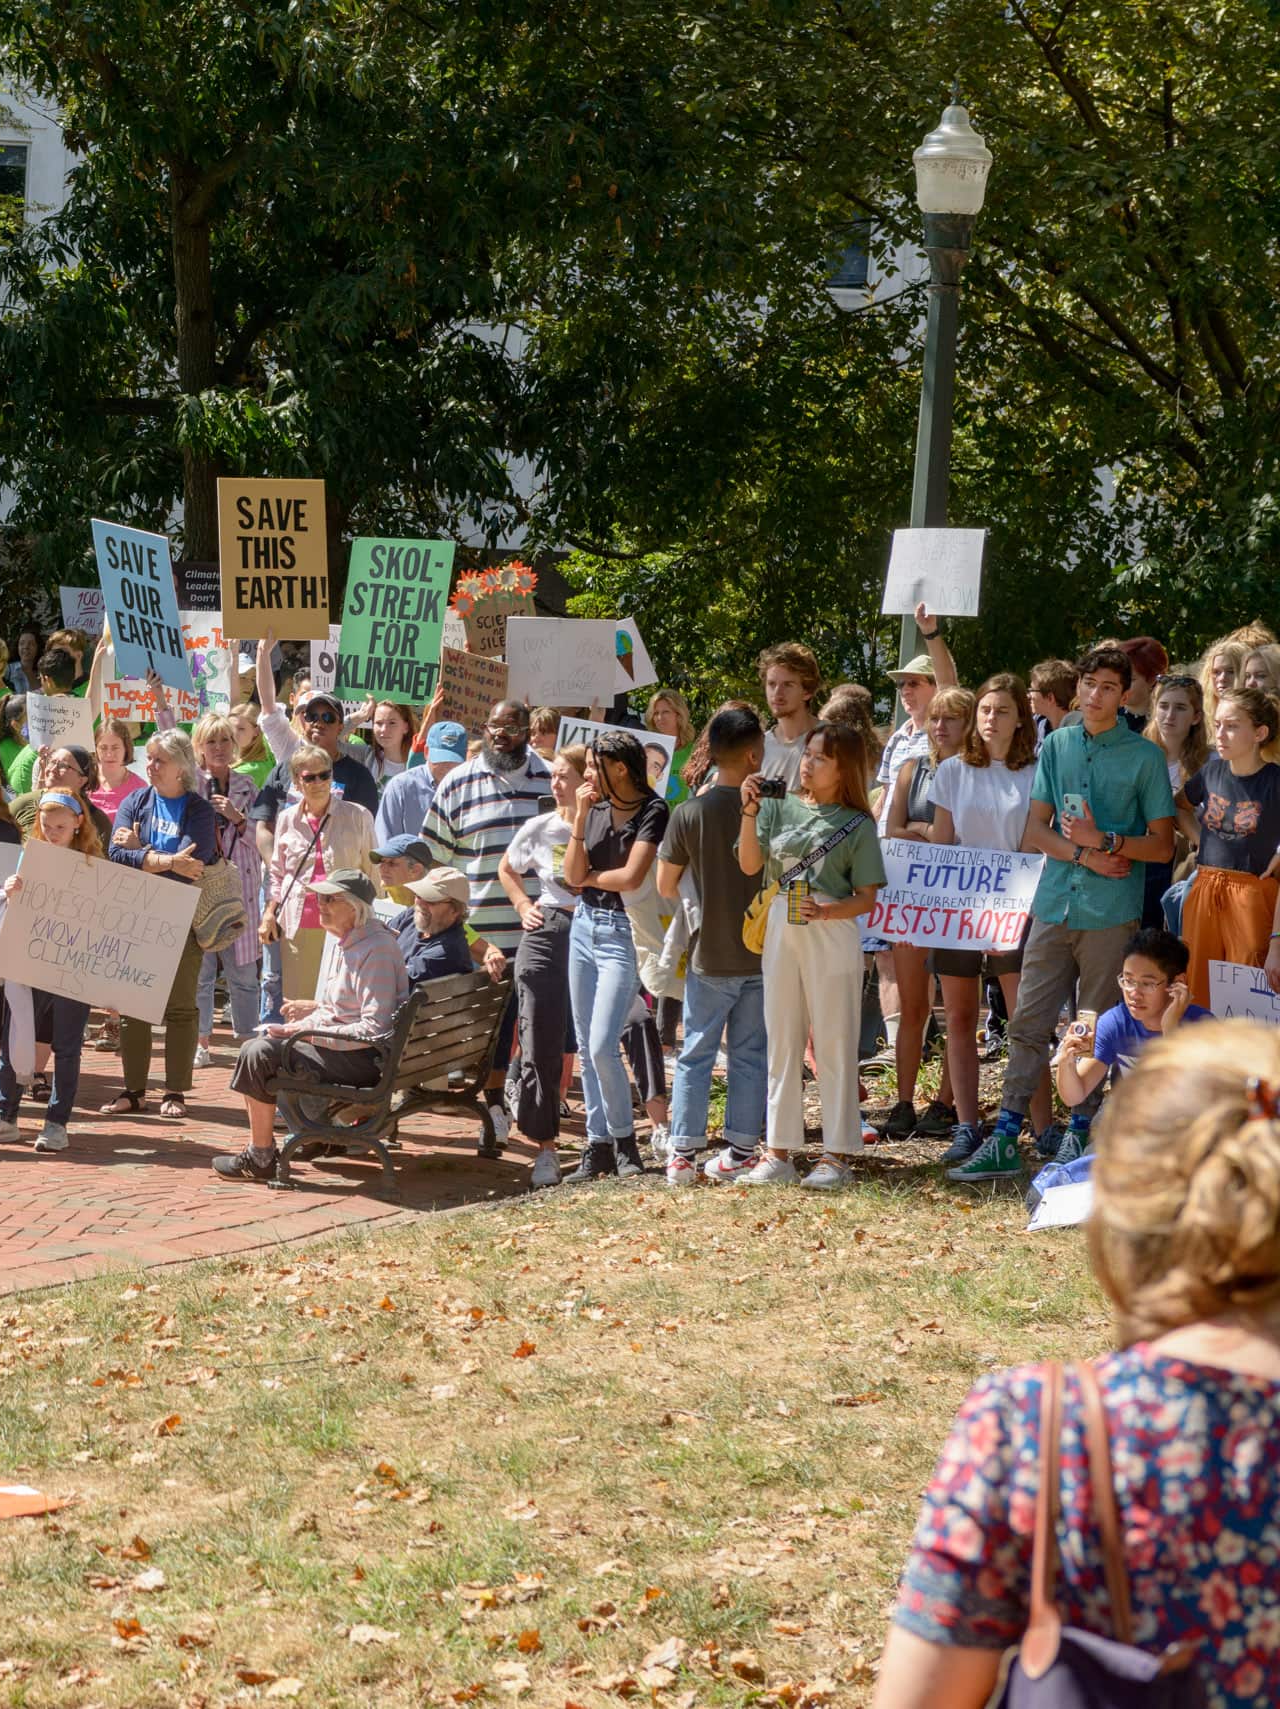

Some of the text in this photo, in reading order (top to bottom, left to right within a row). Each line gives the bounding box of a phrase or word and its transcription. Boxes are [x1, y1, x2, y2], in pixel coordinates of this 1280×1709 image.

[236, 496, 308, 532] SAVE
[105, 536, 160, 581] SAVE
[236, 536, 296, 569] THIS
[369, 545, 444, 583] SKOL-
[121, 577, 163, 620] OUR
[190, 594, 215, 602] Don't
[235, 576, 328, 609] EARTH!
[348, 582, 443, 623] STREJK
[115, 610, 183, 659] EARTH
[369, 619, 420, 657] FÖR
[480, 636, 507, 651] SILE
[105, 683, 172, 708] Thougt
[335, 654, 440, 700] KLIMATET
[885, 843, 1031, 869] WE'RE STUDYING FOR A
[906, 863, 1011, 894] FUTURE
[878, 888, 919, 906] HAT'S
[920, 894, 988, 910] CURRENTLY
[30, 915, 141, 963] KNOW WHAT
[867, 902, 1028, 945] DESTSTROYED
[27, 937, 158, 988] CLIMATE CHANGE
[1216, 964, 1242, 985] IF
